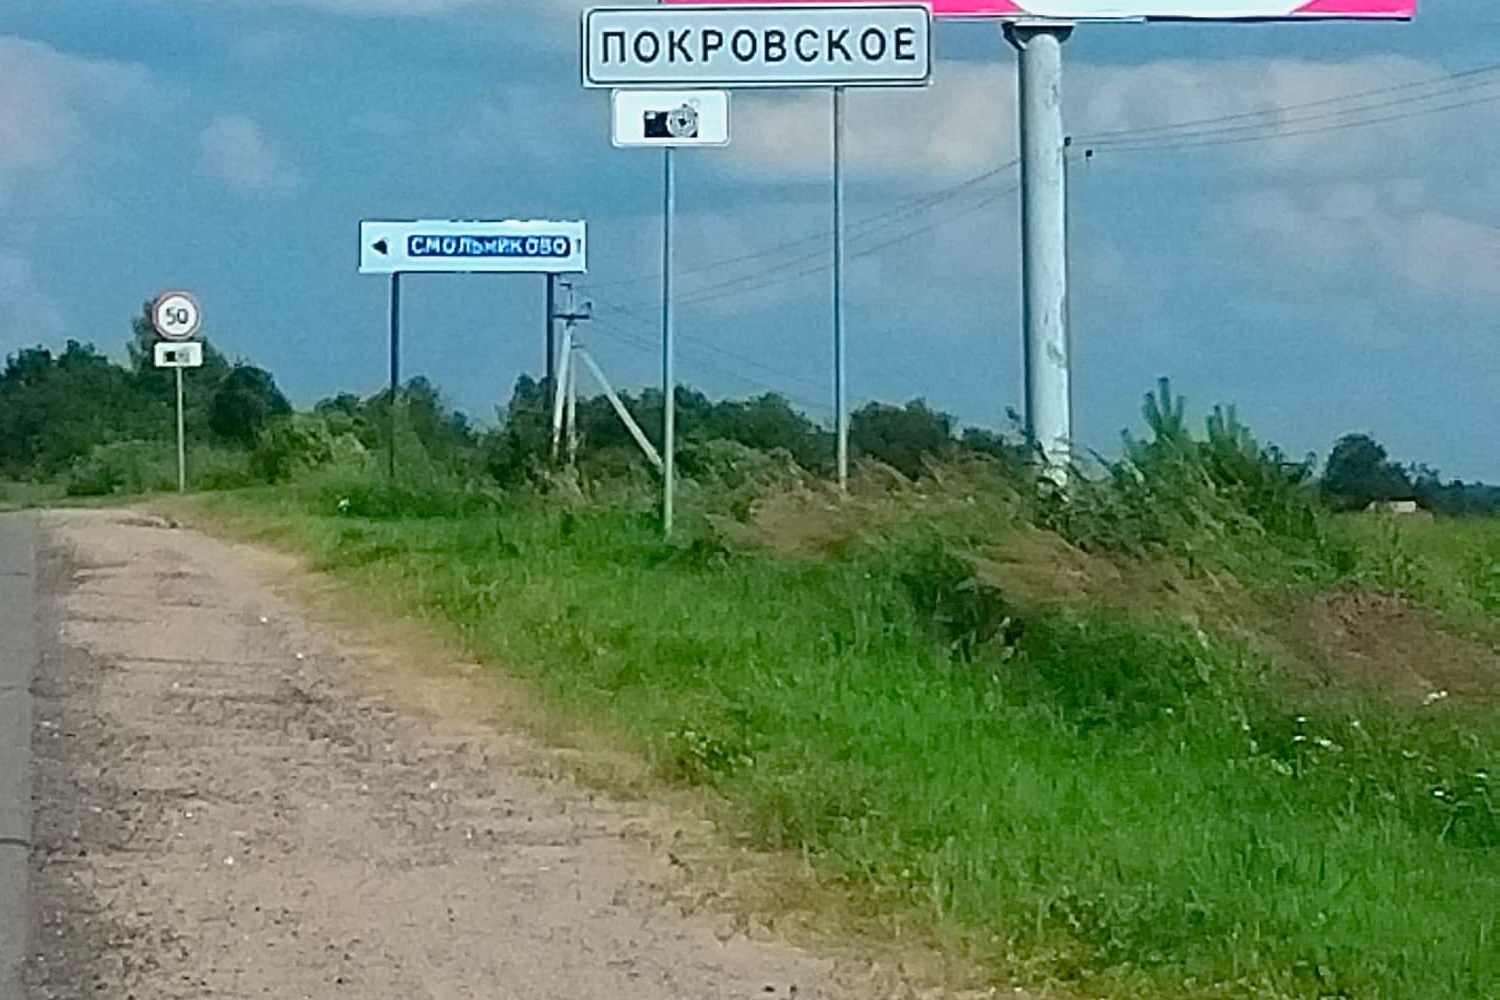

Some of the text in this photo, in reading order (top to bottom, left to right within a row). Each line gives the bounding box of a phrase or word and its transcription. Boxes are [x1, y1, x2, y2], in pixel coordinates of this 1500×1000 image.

[601, 26, 916, 63] ПОКРОВСКОЕ
[411, 236, 569, 255] СМОЛЬНИКОВО
[166, 306, 189, 326] 50
